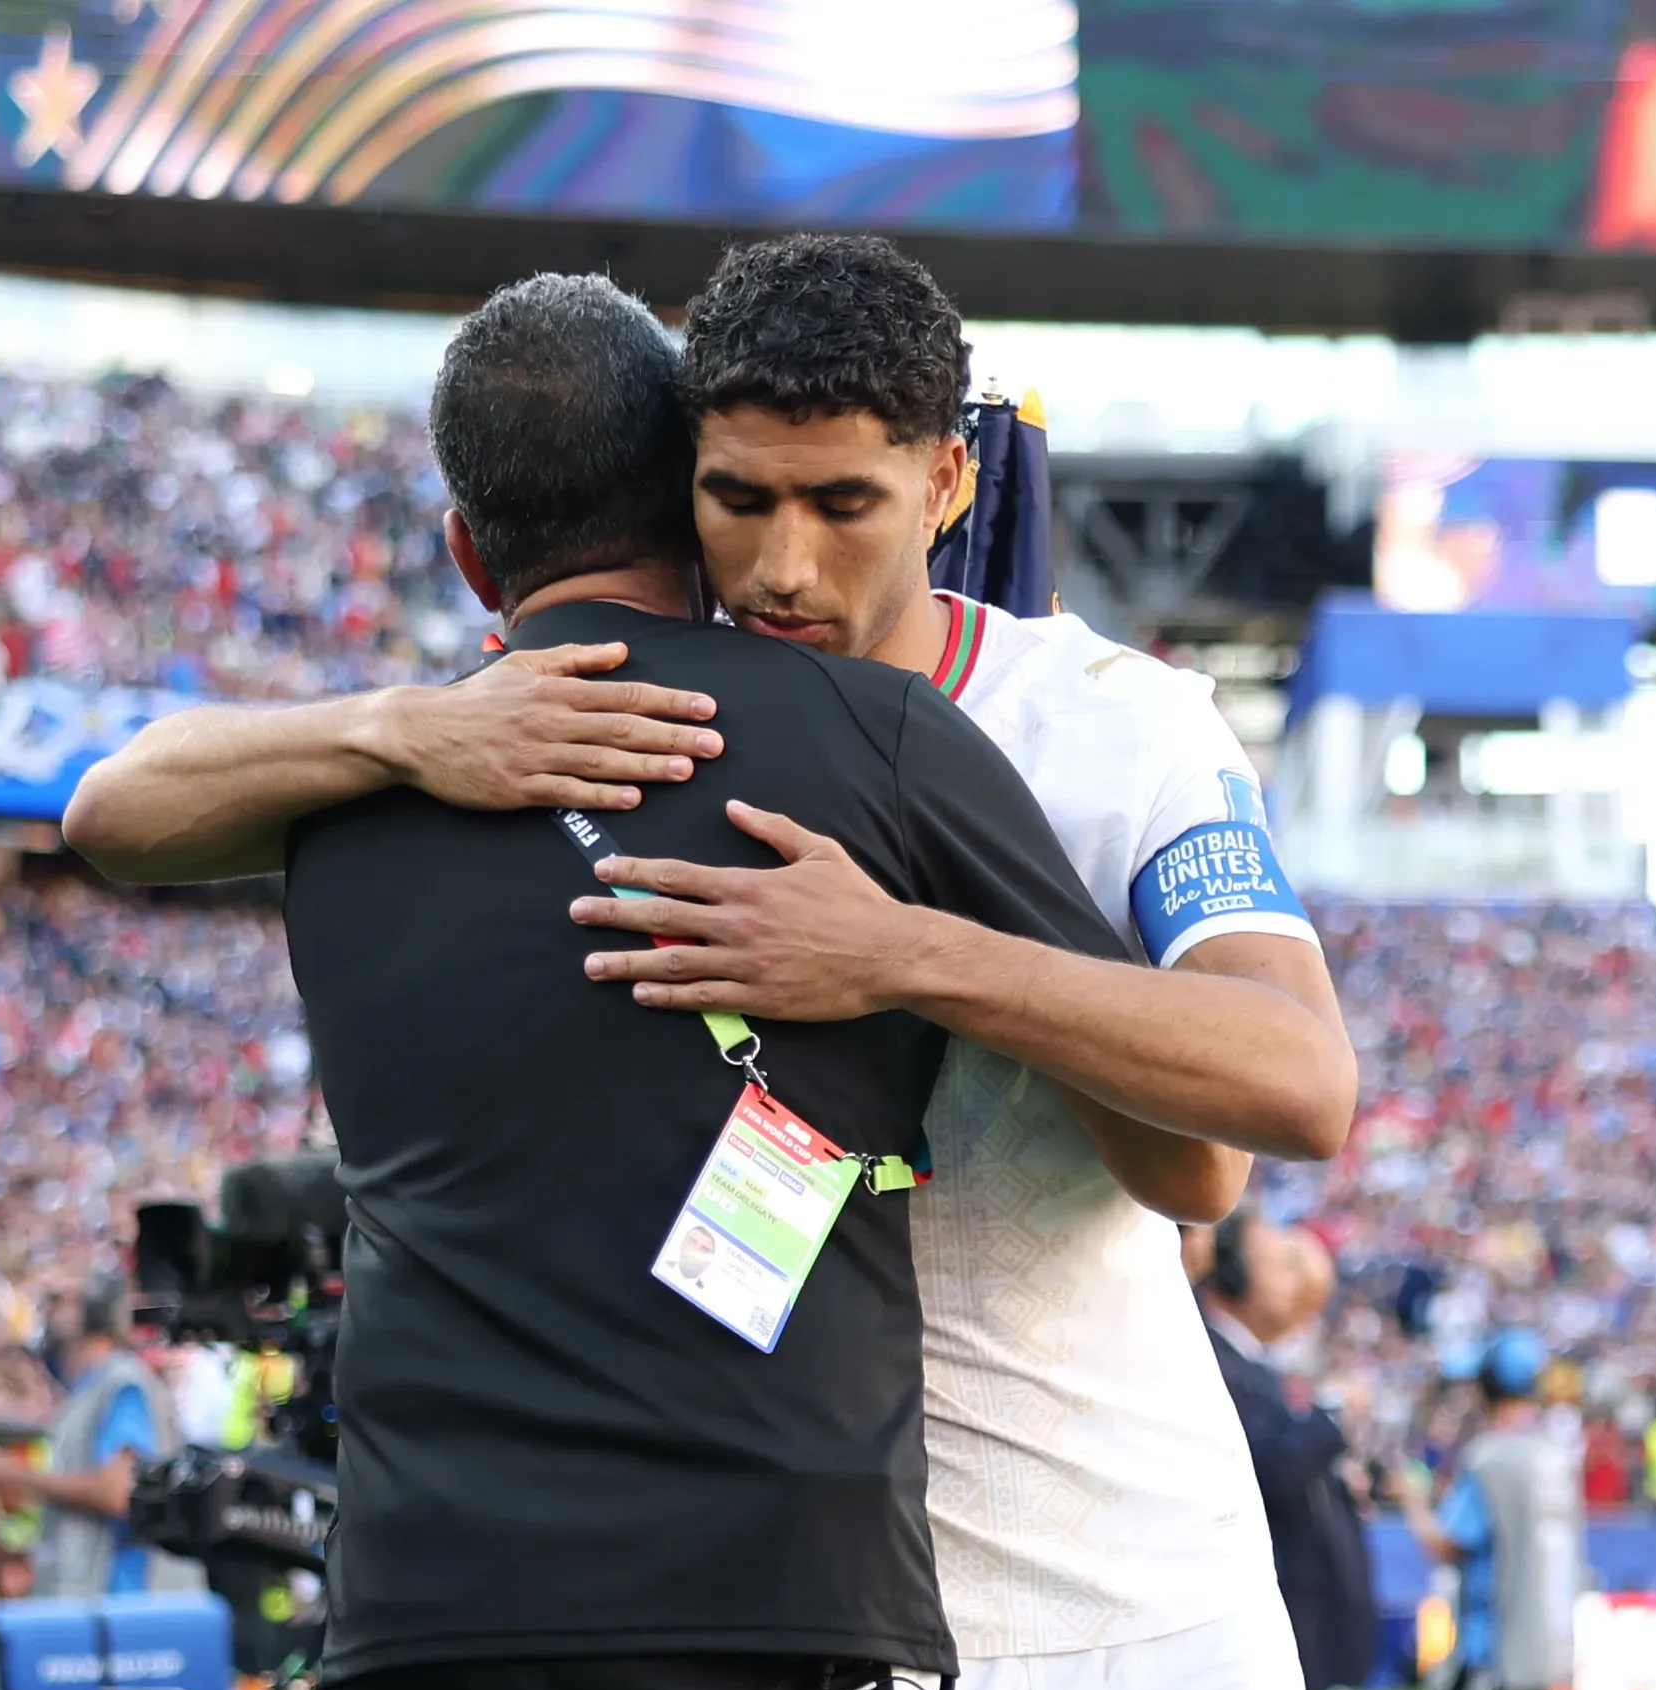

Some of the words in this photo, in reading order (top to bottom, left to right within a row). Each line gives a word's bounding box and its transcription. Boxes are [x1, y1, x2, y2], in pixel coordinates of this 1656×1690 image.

[563, 809, 601, 848] FIFA
[1156, 829, 1259, 874] FOOTBALL
[1158, 850, 1263, 893] UNITES
[1160, 890, 1202, 916] the
[1202, 875, 1278, 896] World
[1204, 896, 1250, 912] FIFA
[743, 1106, 762, 1125] FIFA
[762, 1119, 793, 1148] WORLD
[793, 1143, 812, 1160] CUP
[711, 1173, 736, 1195] TEAM
[734, 1189, 777, 1225] DELEGATE
